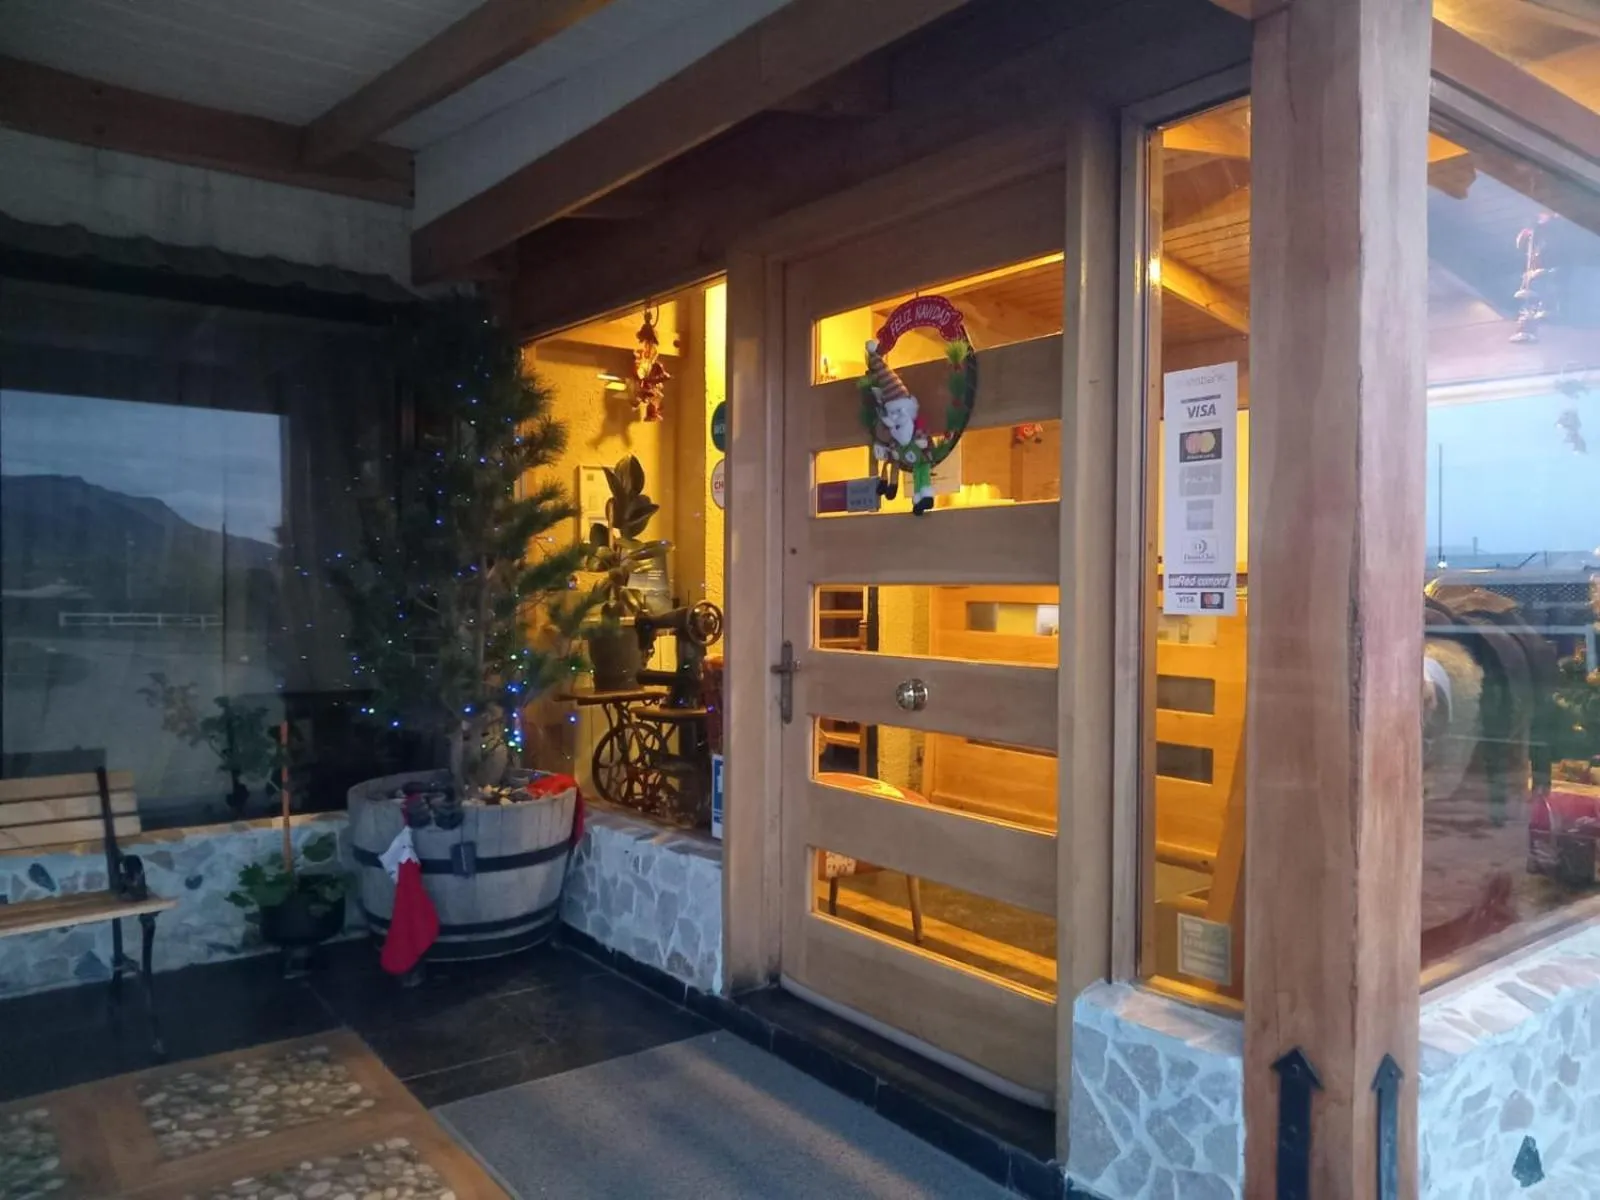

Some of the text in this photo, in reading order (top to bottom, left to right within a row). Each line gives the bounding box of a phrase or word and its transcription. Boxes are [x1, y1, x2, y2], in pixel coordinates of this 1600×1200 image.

[890, 303, 952, 337] FELIZ NAVIDAD
[1187, 403, 1217, 419] VISA
[1178, 595, 1195, 604] VISA
